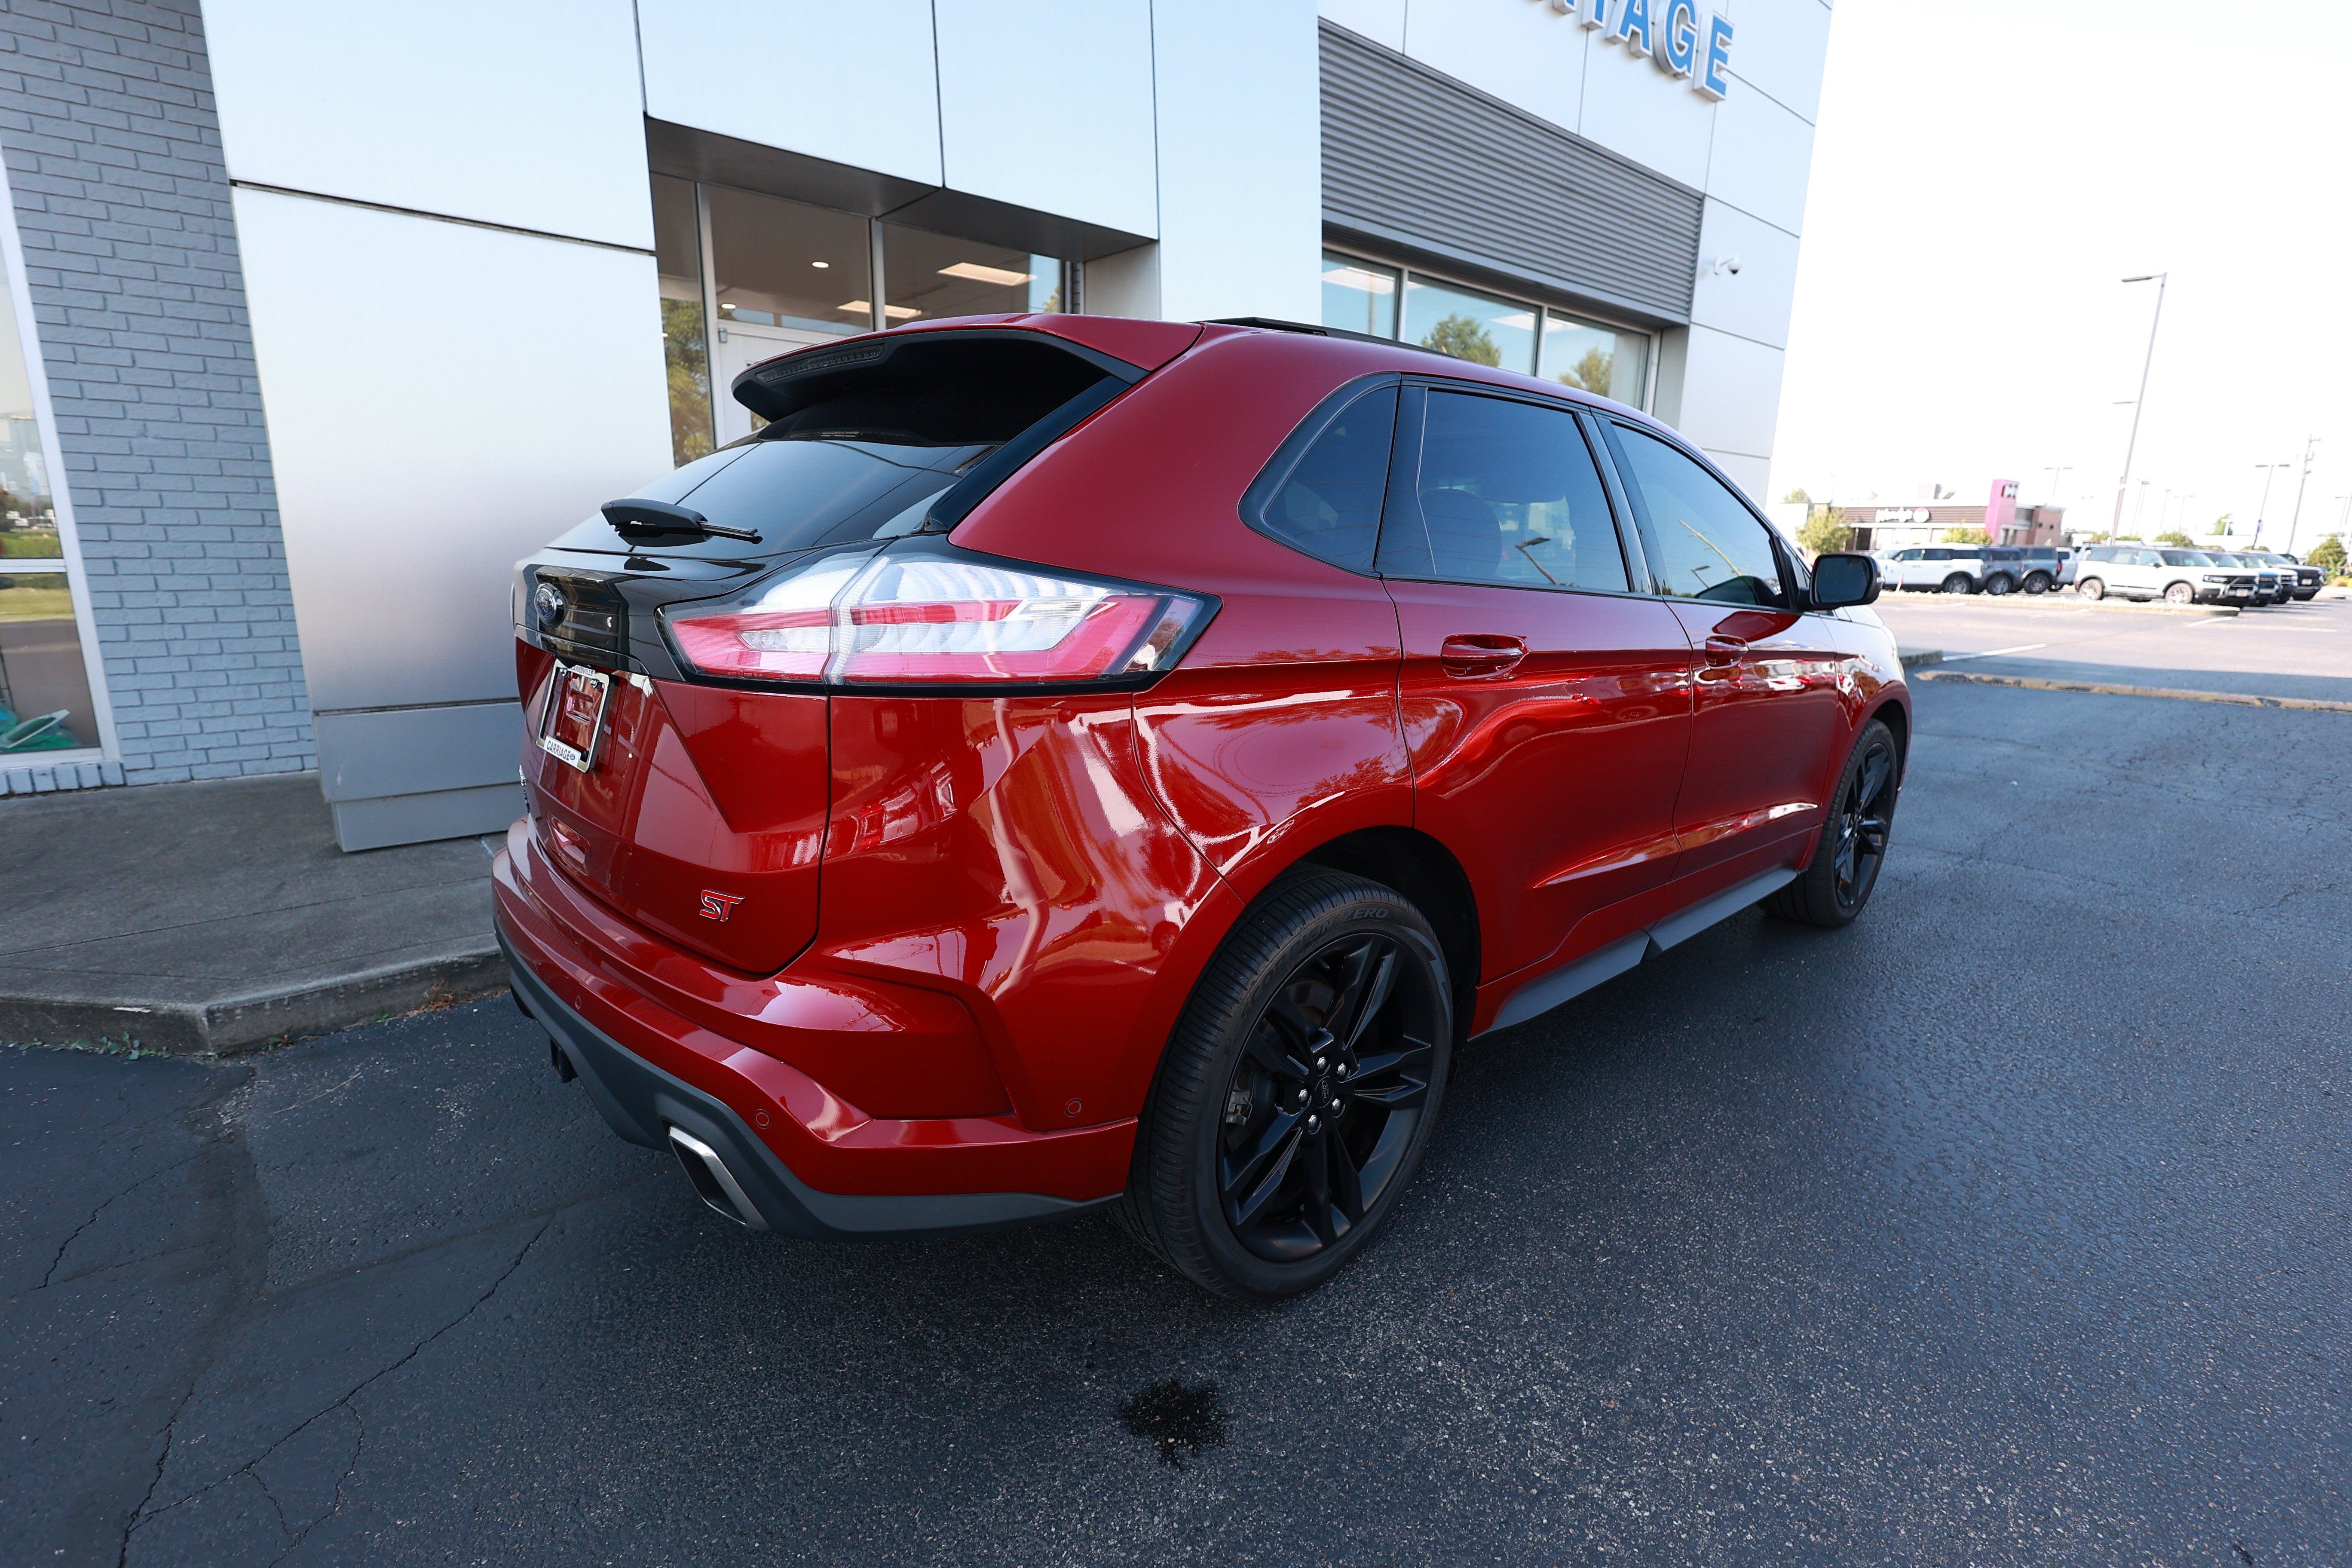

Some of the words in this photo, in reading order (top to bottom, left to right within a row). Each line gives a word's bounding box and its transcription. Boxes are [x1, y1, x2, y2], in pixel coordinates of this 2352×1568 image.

[1551, 0, 1736, 101] AGE
[547, 740, 571, 761] CARRIAGE
[699, 889, 745, 922] ST
[1241, 917, 1335, 1019] SCORPION
[1342, 907, 1389, 922] ZERO
